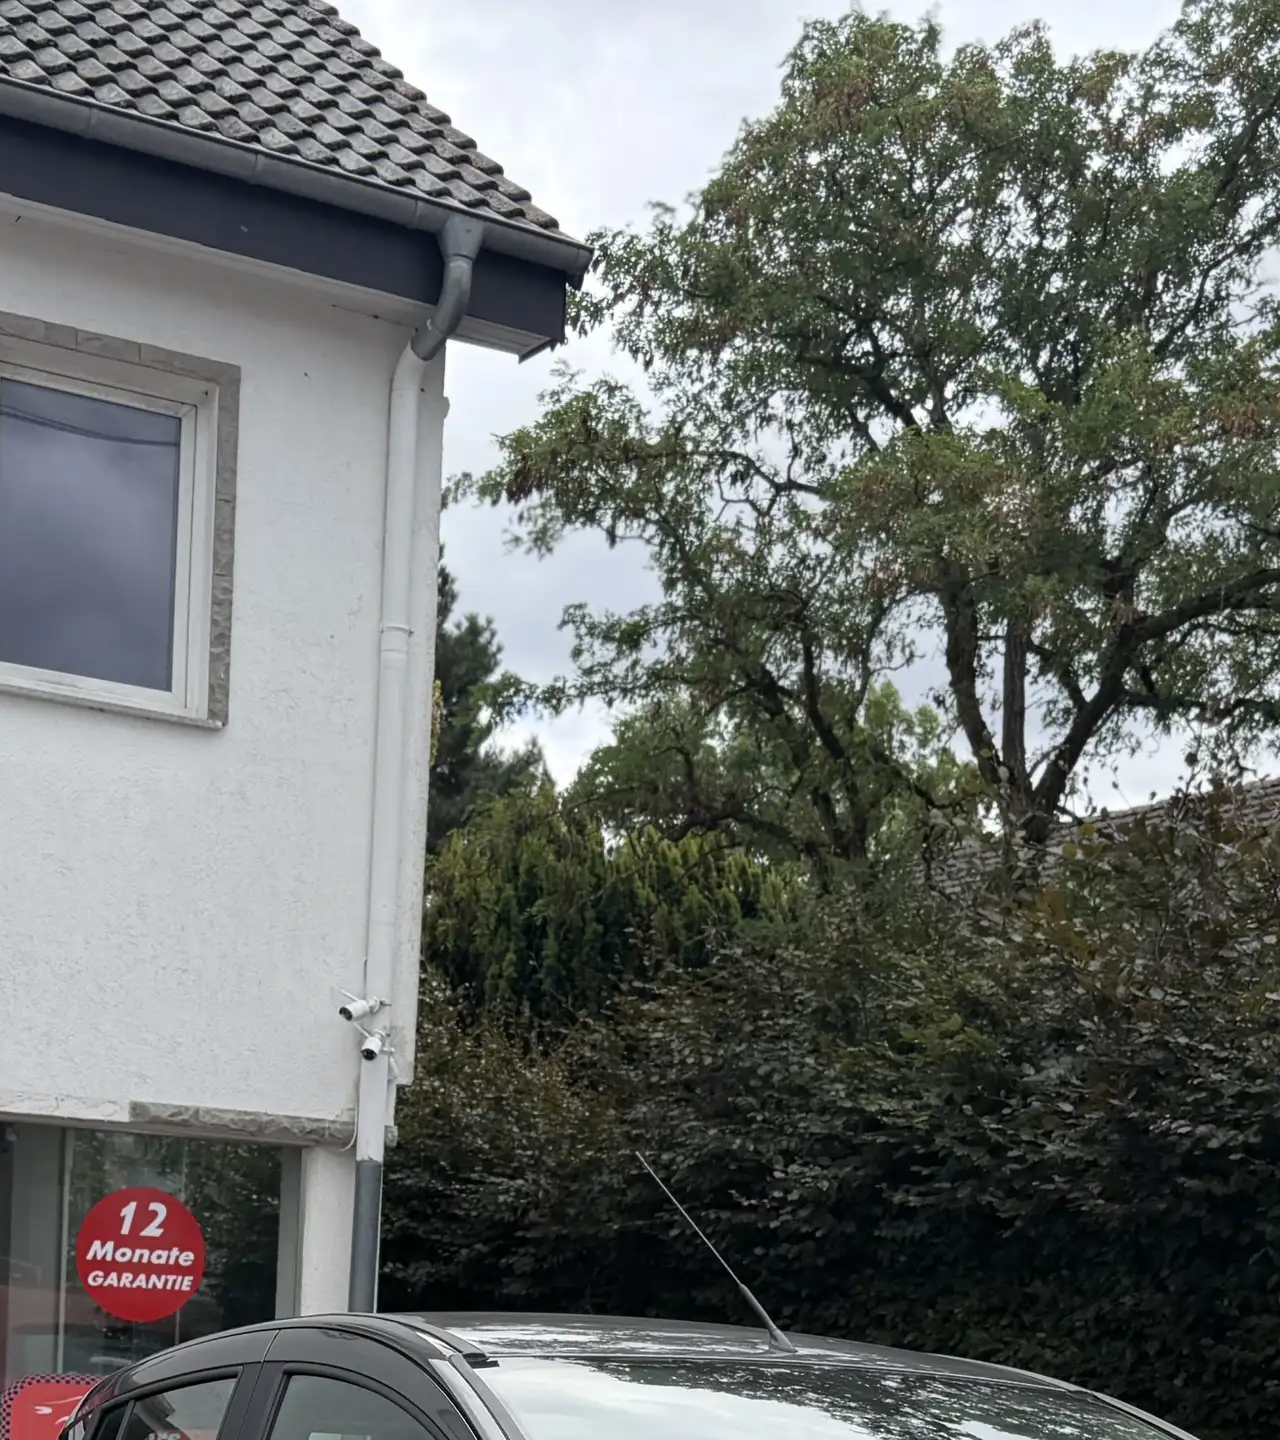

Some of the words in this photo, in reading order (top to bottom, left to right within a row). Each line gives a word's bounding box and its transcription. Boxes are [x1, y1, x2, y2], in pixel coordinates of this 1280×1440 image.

[120, 1201, 168, 1238] 12
[86, 1240, 195, 1267] Monate
[87, 1270, 194, 1292] GARANTIE
